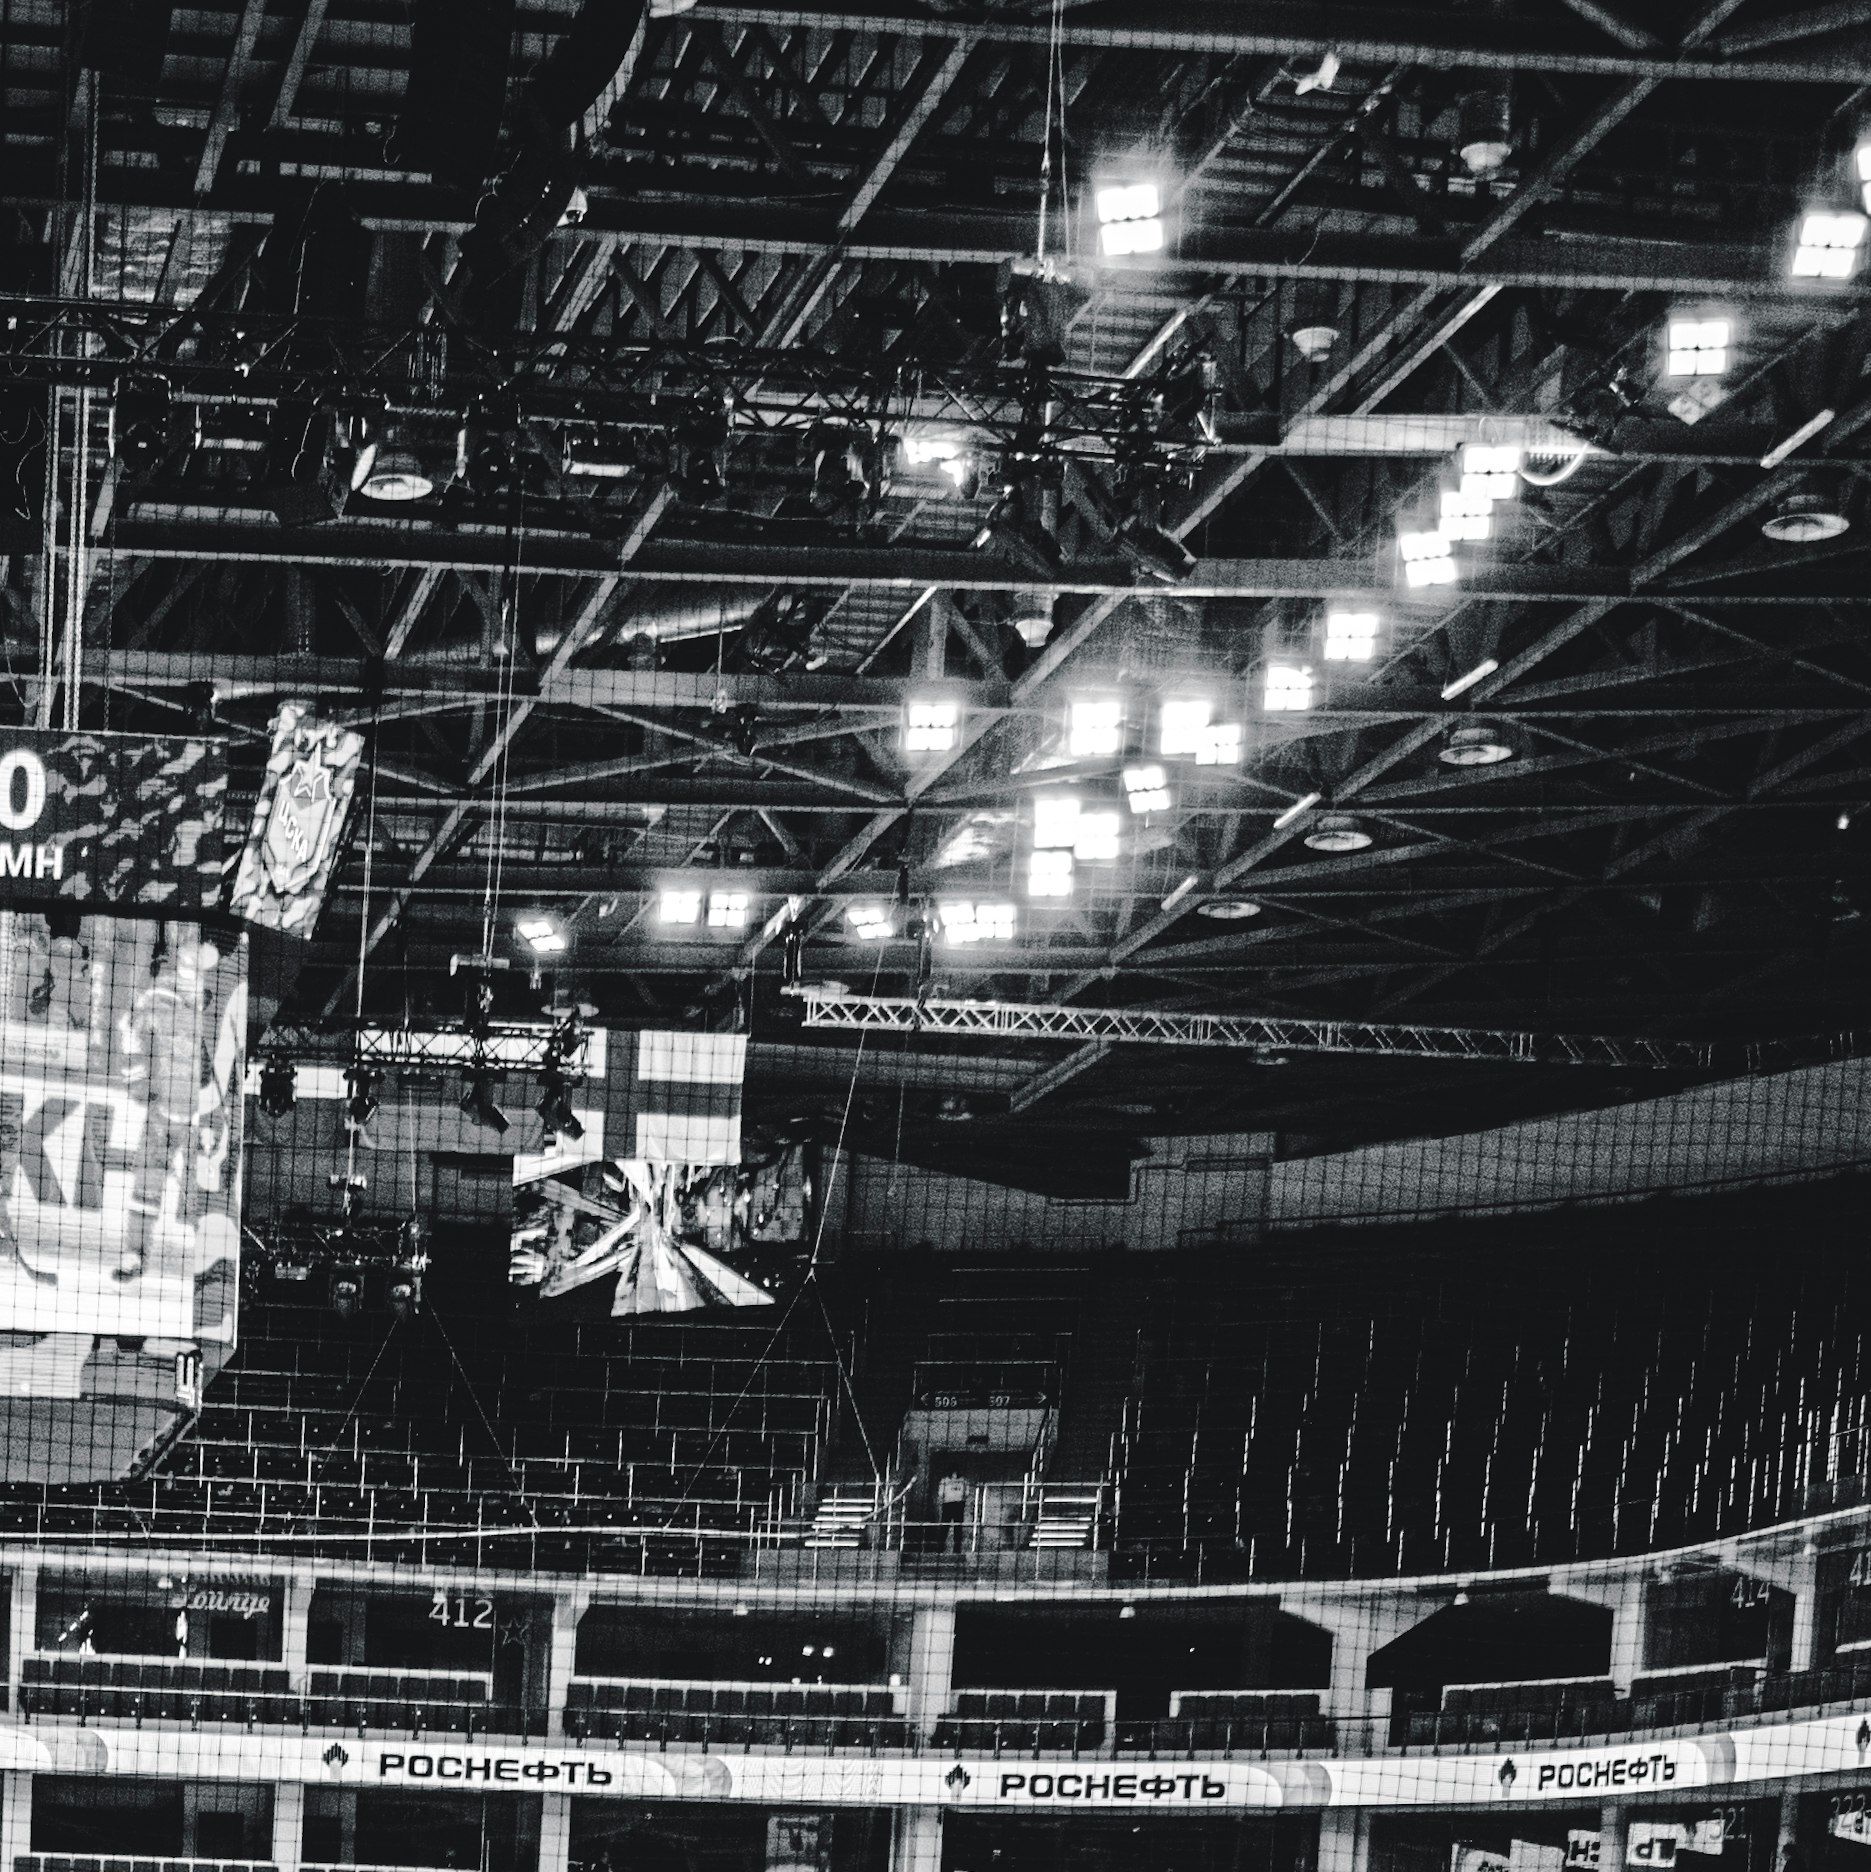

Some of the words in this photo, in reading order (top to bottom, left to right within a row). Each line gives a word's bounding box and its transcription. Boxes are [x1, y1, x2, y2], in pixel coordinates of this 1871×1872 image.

[278, 800, 308, 862] ЦСКА
[430, 1600, 493, 1628] 412
[380, 1754, 612, 1785] РОСНЕФТЬ
[1538, 1754, 1676, 1791] РОСНЕФТЬ
[1000, 1774, 1225, 1799] РОСНЕФТЬ
